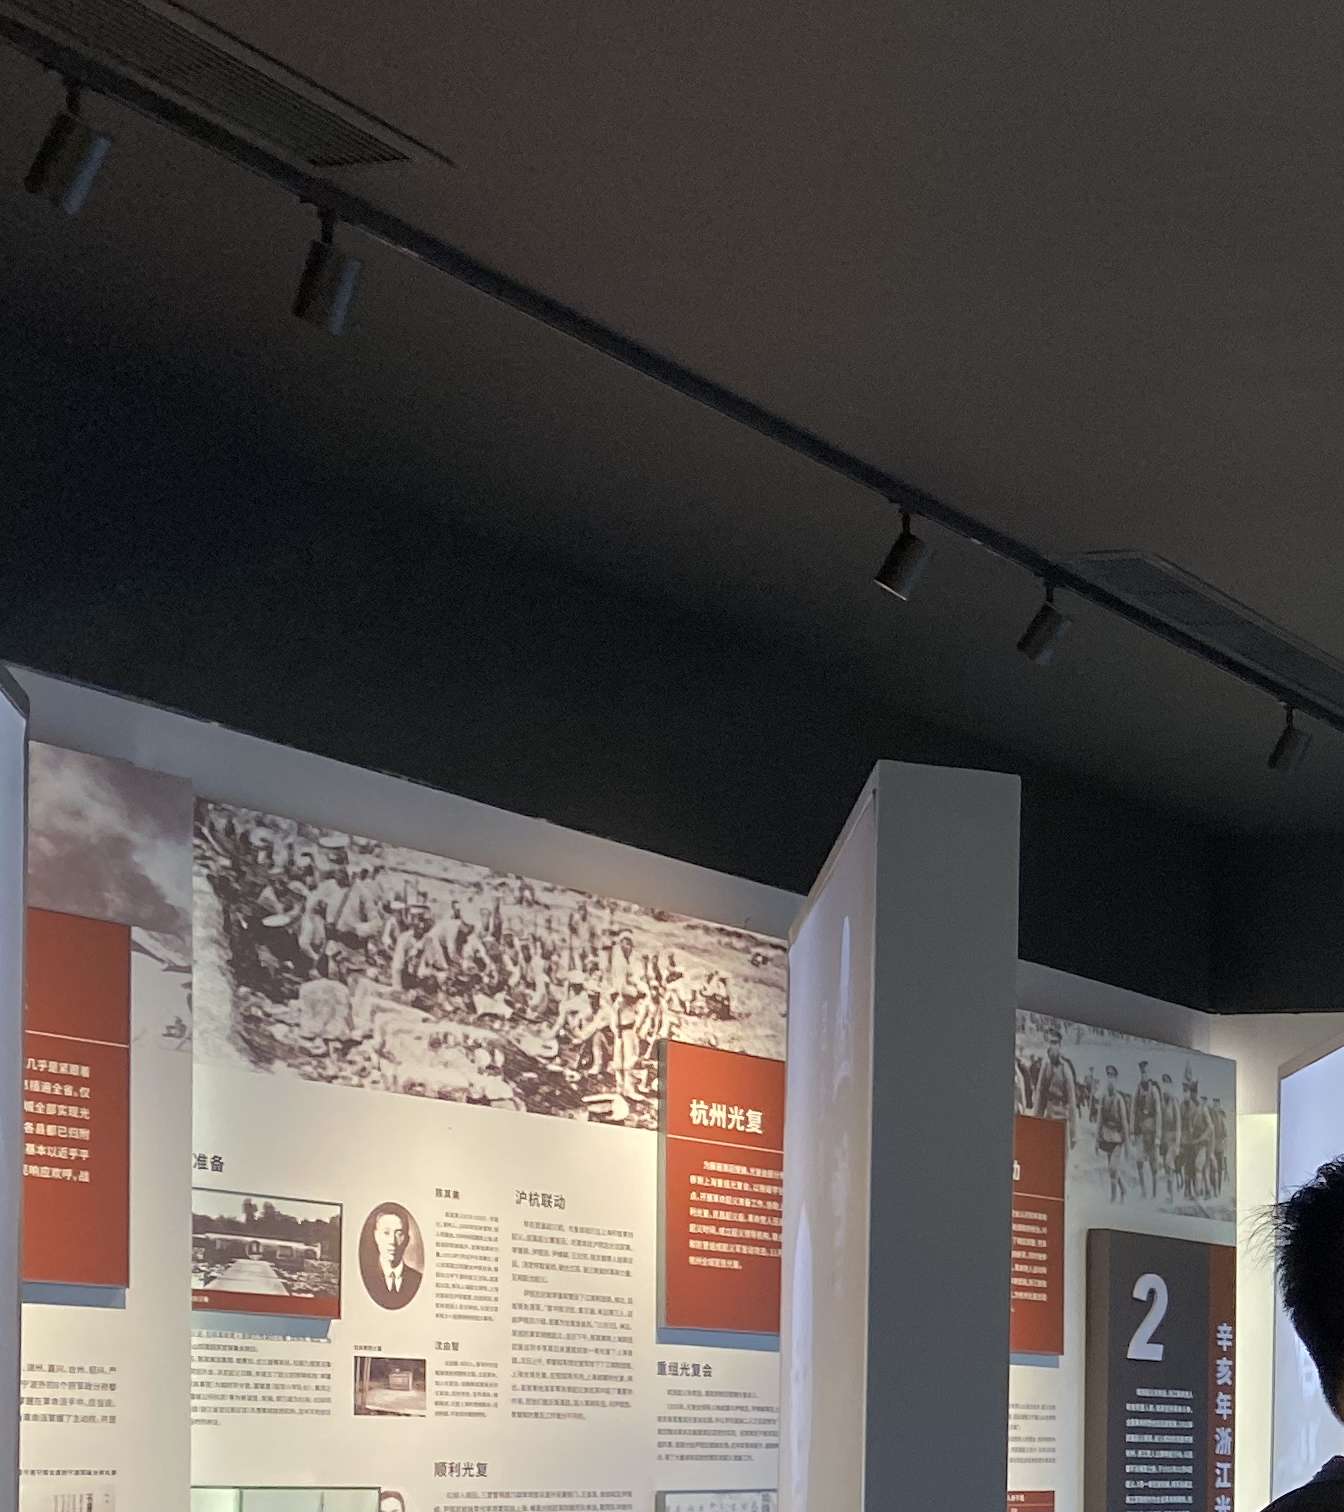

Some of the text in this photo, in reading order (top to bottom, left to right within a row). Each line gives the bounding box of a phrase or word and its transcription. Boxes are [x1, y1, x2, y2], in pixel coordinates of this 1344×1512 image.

[689, 1098, 764, 1134] 杭州光复
[515, 1189, 566, 1210] 沪杭联动
[1126, 1273, 1170, 1362] 2
[434, 1461, 488, 1478] 顺利光复
